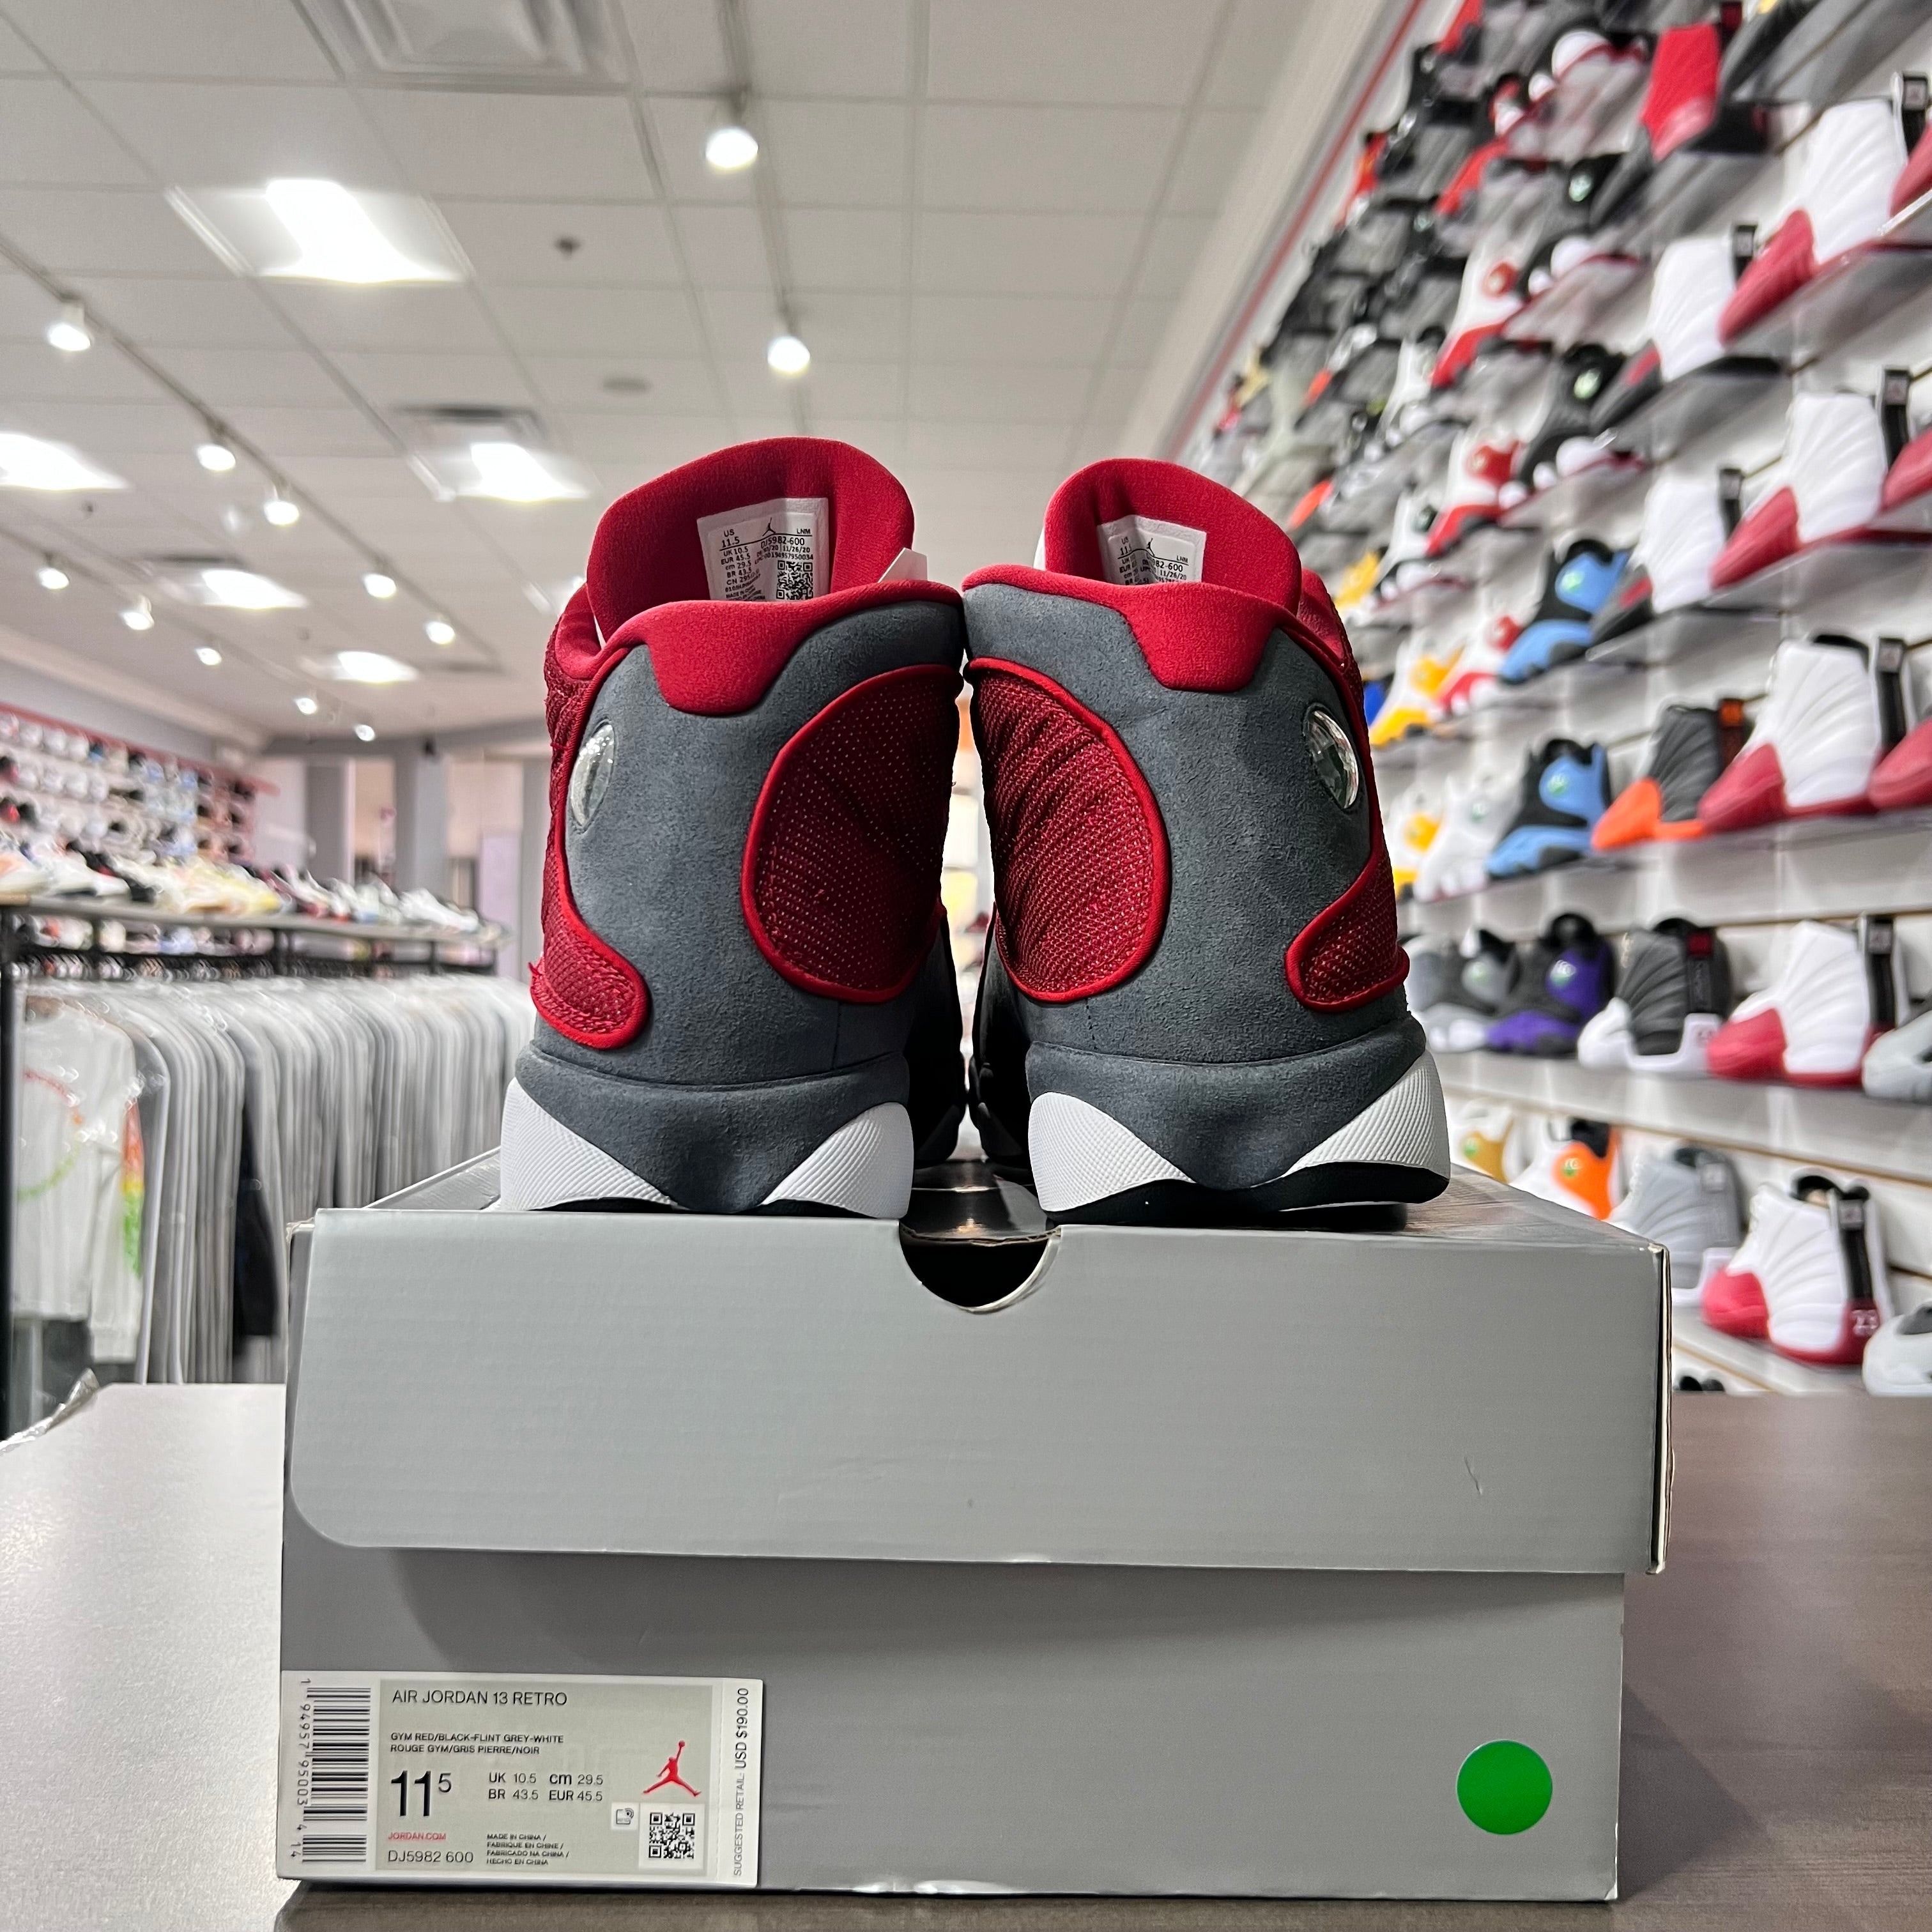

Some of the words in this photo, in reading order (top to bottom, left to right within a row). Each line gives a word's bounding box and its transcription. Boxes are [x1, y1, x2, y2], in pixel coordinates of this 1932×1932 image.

[722, 537, 740, 548] 11.5
[734, 546, 748, 555] 10.5
[783, 545, 810, 553] 11/26/20
[737, 560, 751, 569] 29.5
[1119, 564, 1131, 573] EUR
[739, 567, 752, 576] 43.5
[1160, 570, 1186, 580] 11/26/20
[392, 1690, 417, 1704] AIR
[422, 1690, 488, 1705] JORDAN
[493, 1691, 508, 1705] 13
[513, 1692, 567, 1705] RETRO
[736, 1688, 748, 1738] $190.00
[299, 1704, 311, 1749] 94957
[390, 1732, 412, 1742] GYM
[415, 1732, 500, 1742] RED/BLACK-FLINT
[503, 1734, 564, 1744] GREY-WHITE
[390, 1744, 424, 1752] ROUGE
[427, 1744, 475, 1754] GYM/GRIS
[478, 1745, 540, 1754] PIERRE/NOIR
[735, 1742, 746, 1768] USD
[297, 1760, 309, 1805] 95003
[489, 1772, 506, 1783] UK
[514, 1772, 537, 1784] 10.5
[549, 1774, 572, 1785] cm
[578, 1774, 604, 1785] 29.5
[488, 1789, 506, 1800] BR
[512, 1789, 539, 1800] 43.5
[549, 1790, 574, 1800] EUR
[577, 1791, 603, 1802] 45.5
[388, 1832, 447, 1841] JORDAN.COM
[733, 1813, 743, 1876] SUGGESTED
[388, 1850, 441, 1863] DJ5982
[446, 1850, 473, 1864] 600
